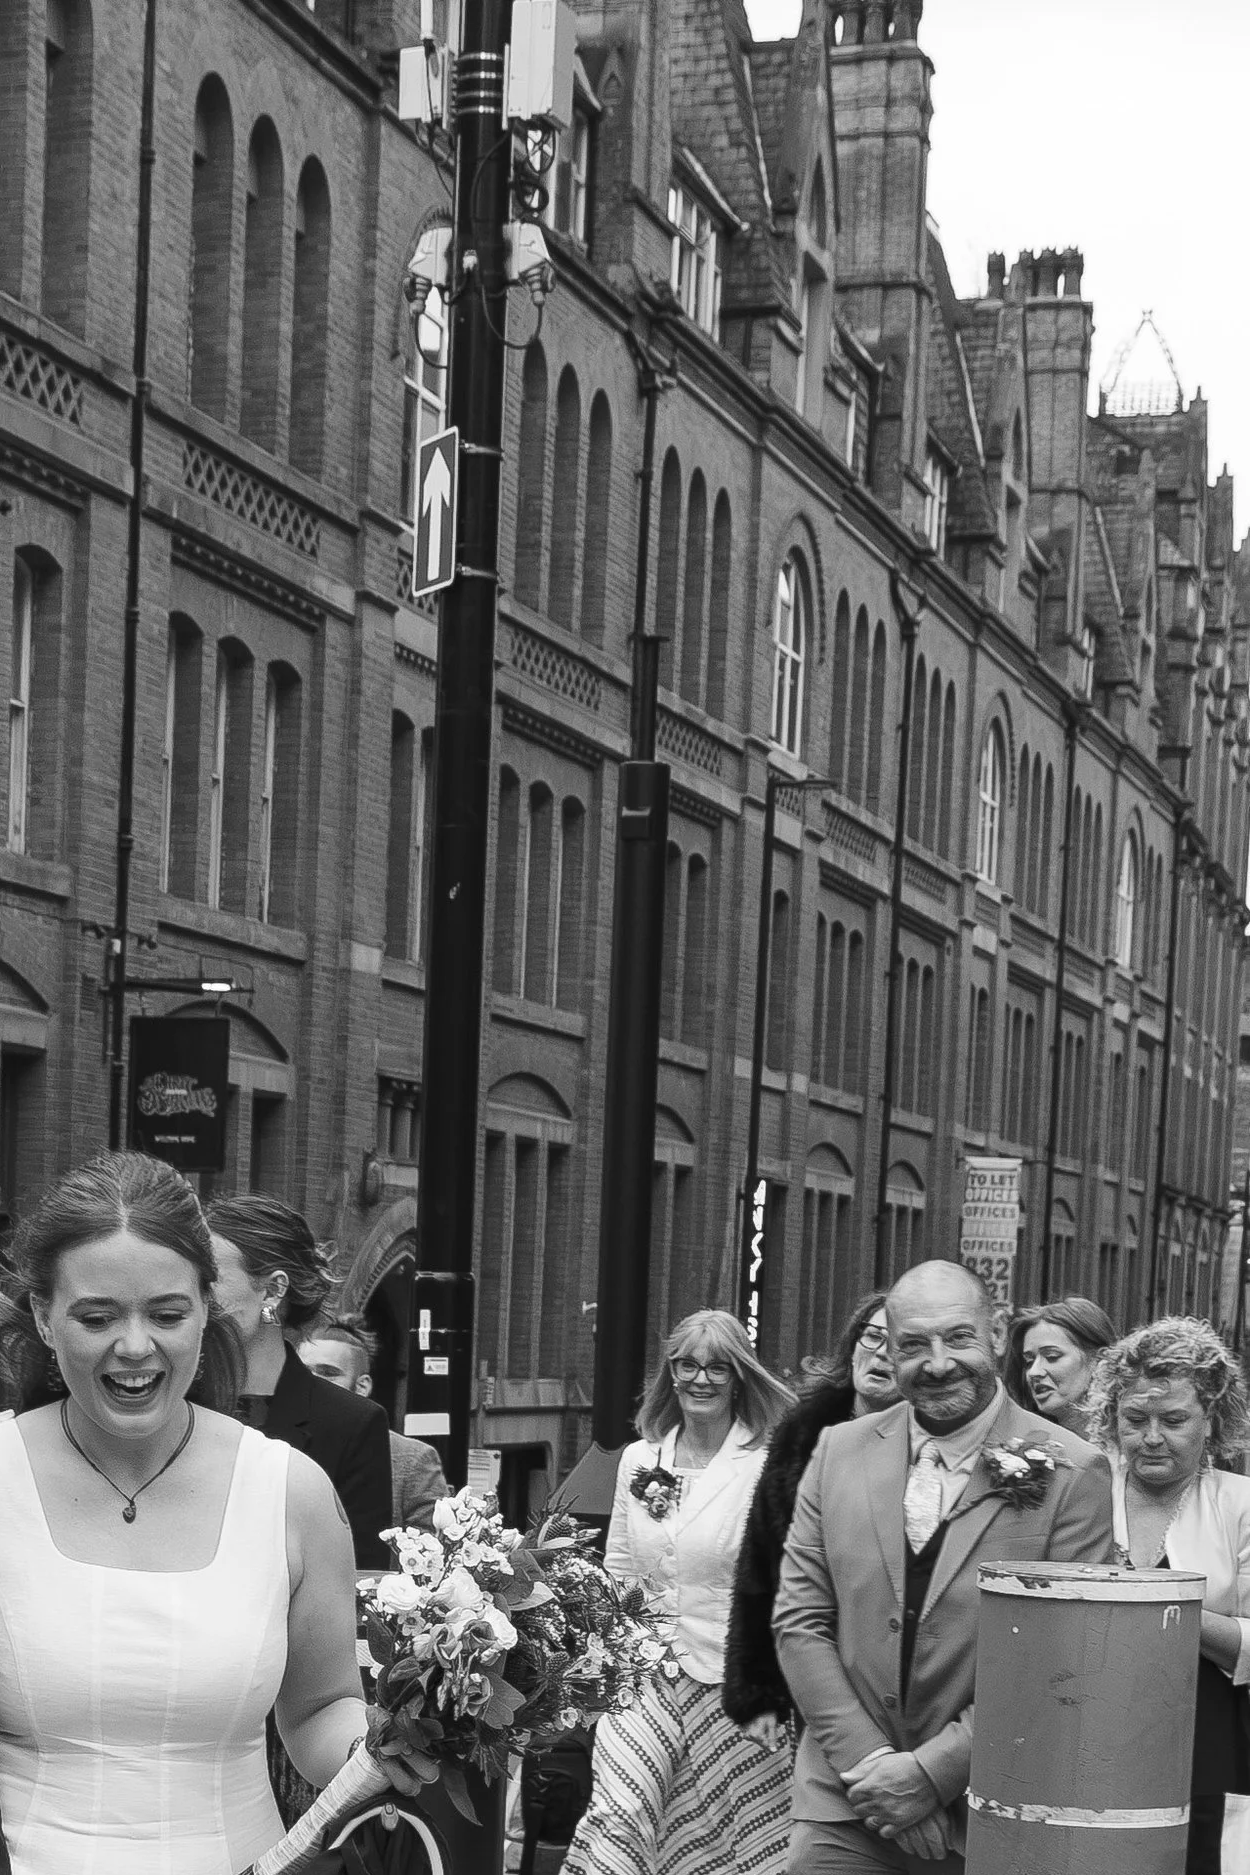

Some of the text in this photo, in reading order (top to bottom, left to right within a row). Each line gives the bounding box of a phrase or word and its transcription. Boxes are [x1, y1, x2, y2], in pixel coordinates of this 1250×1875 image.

[969, 1173, 1016, 1186] TO LET
[965, 1188, 1019, 1202] OFFICES
[963, 1205, 1017, 1218] OFFICES
[962, 1238, 1015, 1253] OFFICES
